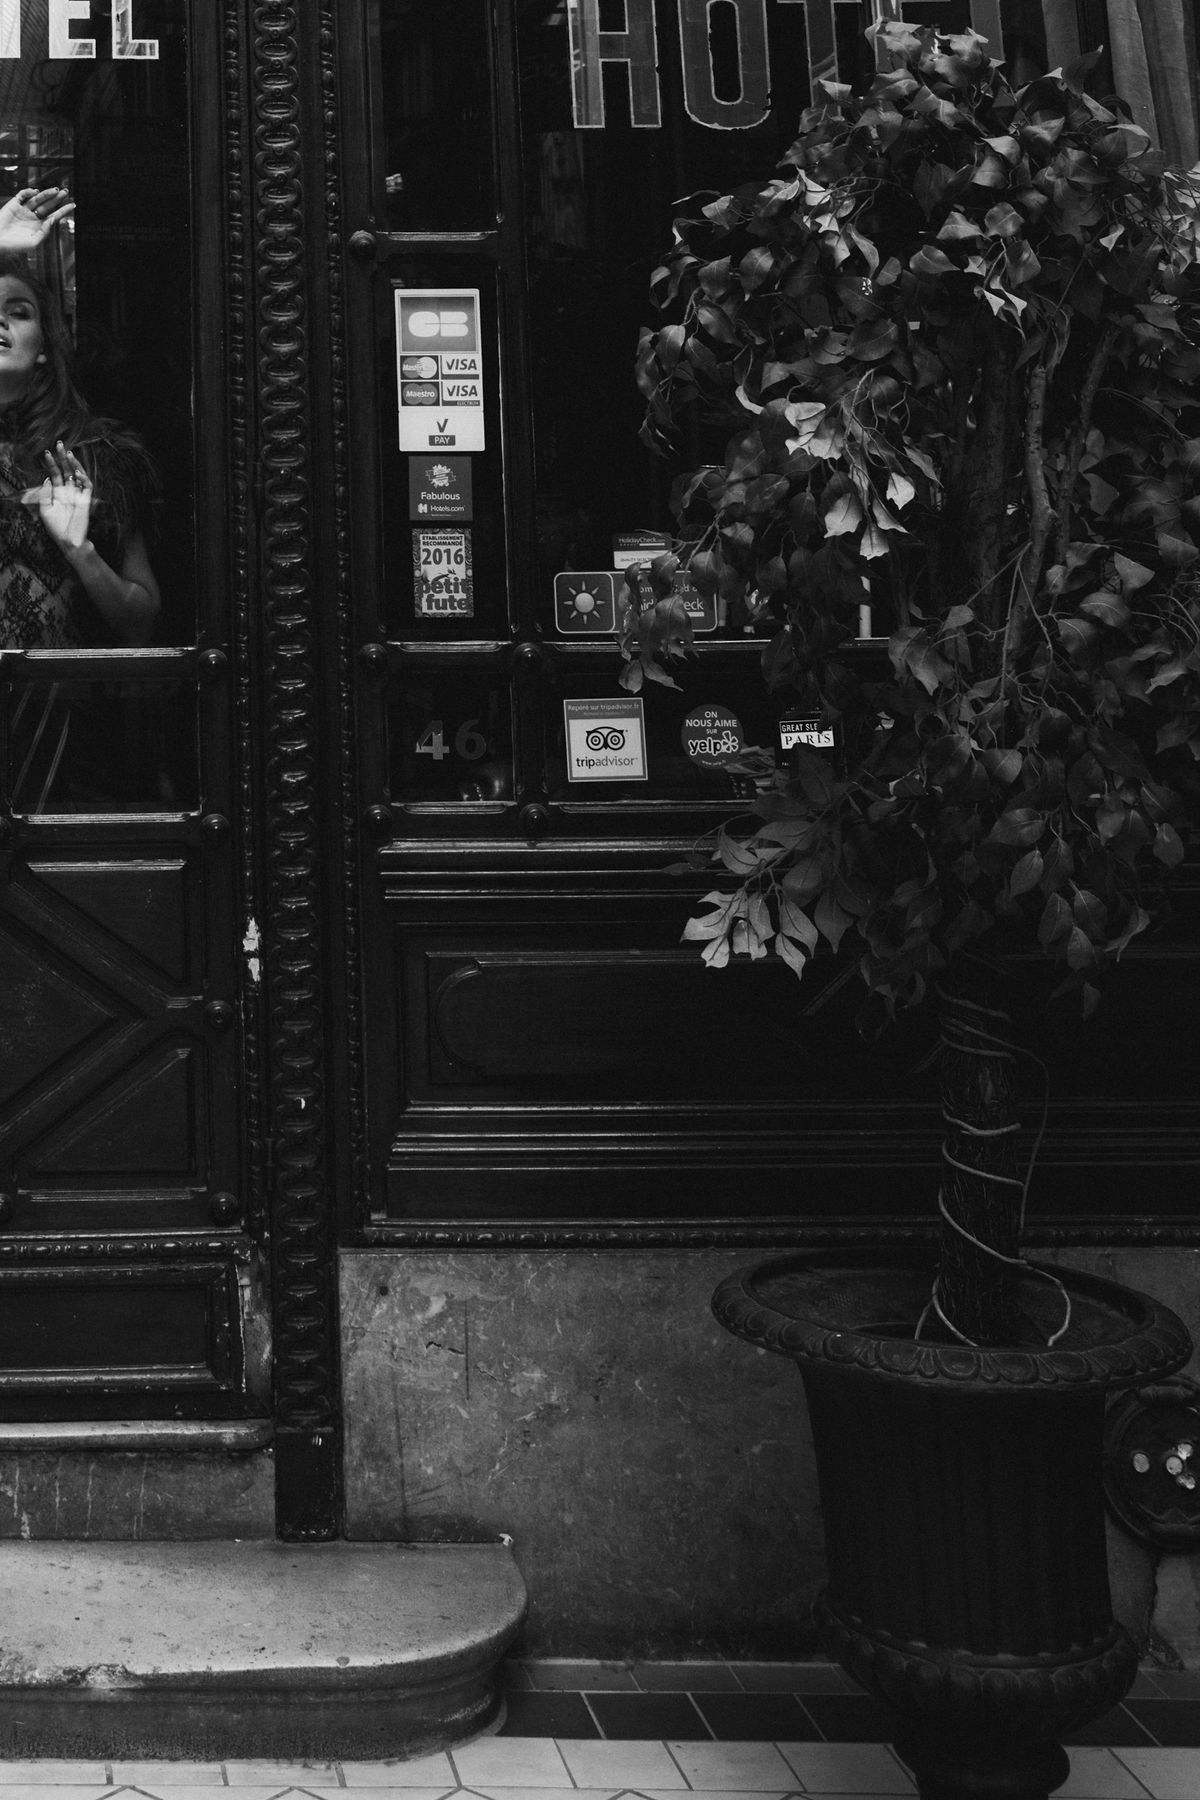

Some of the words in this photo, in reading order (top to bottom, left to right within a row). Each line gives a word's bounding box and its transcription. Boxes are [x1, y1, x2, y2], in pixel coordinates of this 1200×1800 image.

[408, 311, 468, 337] CB
[446, 358, 477, 370] VISA
[405, 390, 435, 398] Maestro
[447, 385, 478, 397] VISA
[434, 436, 450, 445] PAY
[421, 491, 461, 500] Fabulous
[421, 548, 464, 565] 2016
[685, 719, 712, 727] NOUS
[714, 719, 738, 727] AIME
[781, 723, 803, 732] GREAT
[415, 719, 487, 760] 46
[785, 733, 831, 745] PARIS
[688, 737, 723, 756] yelp
[576, 755, 635, 769] tripadvisor
